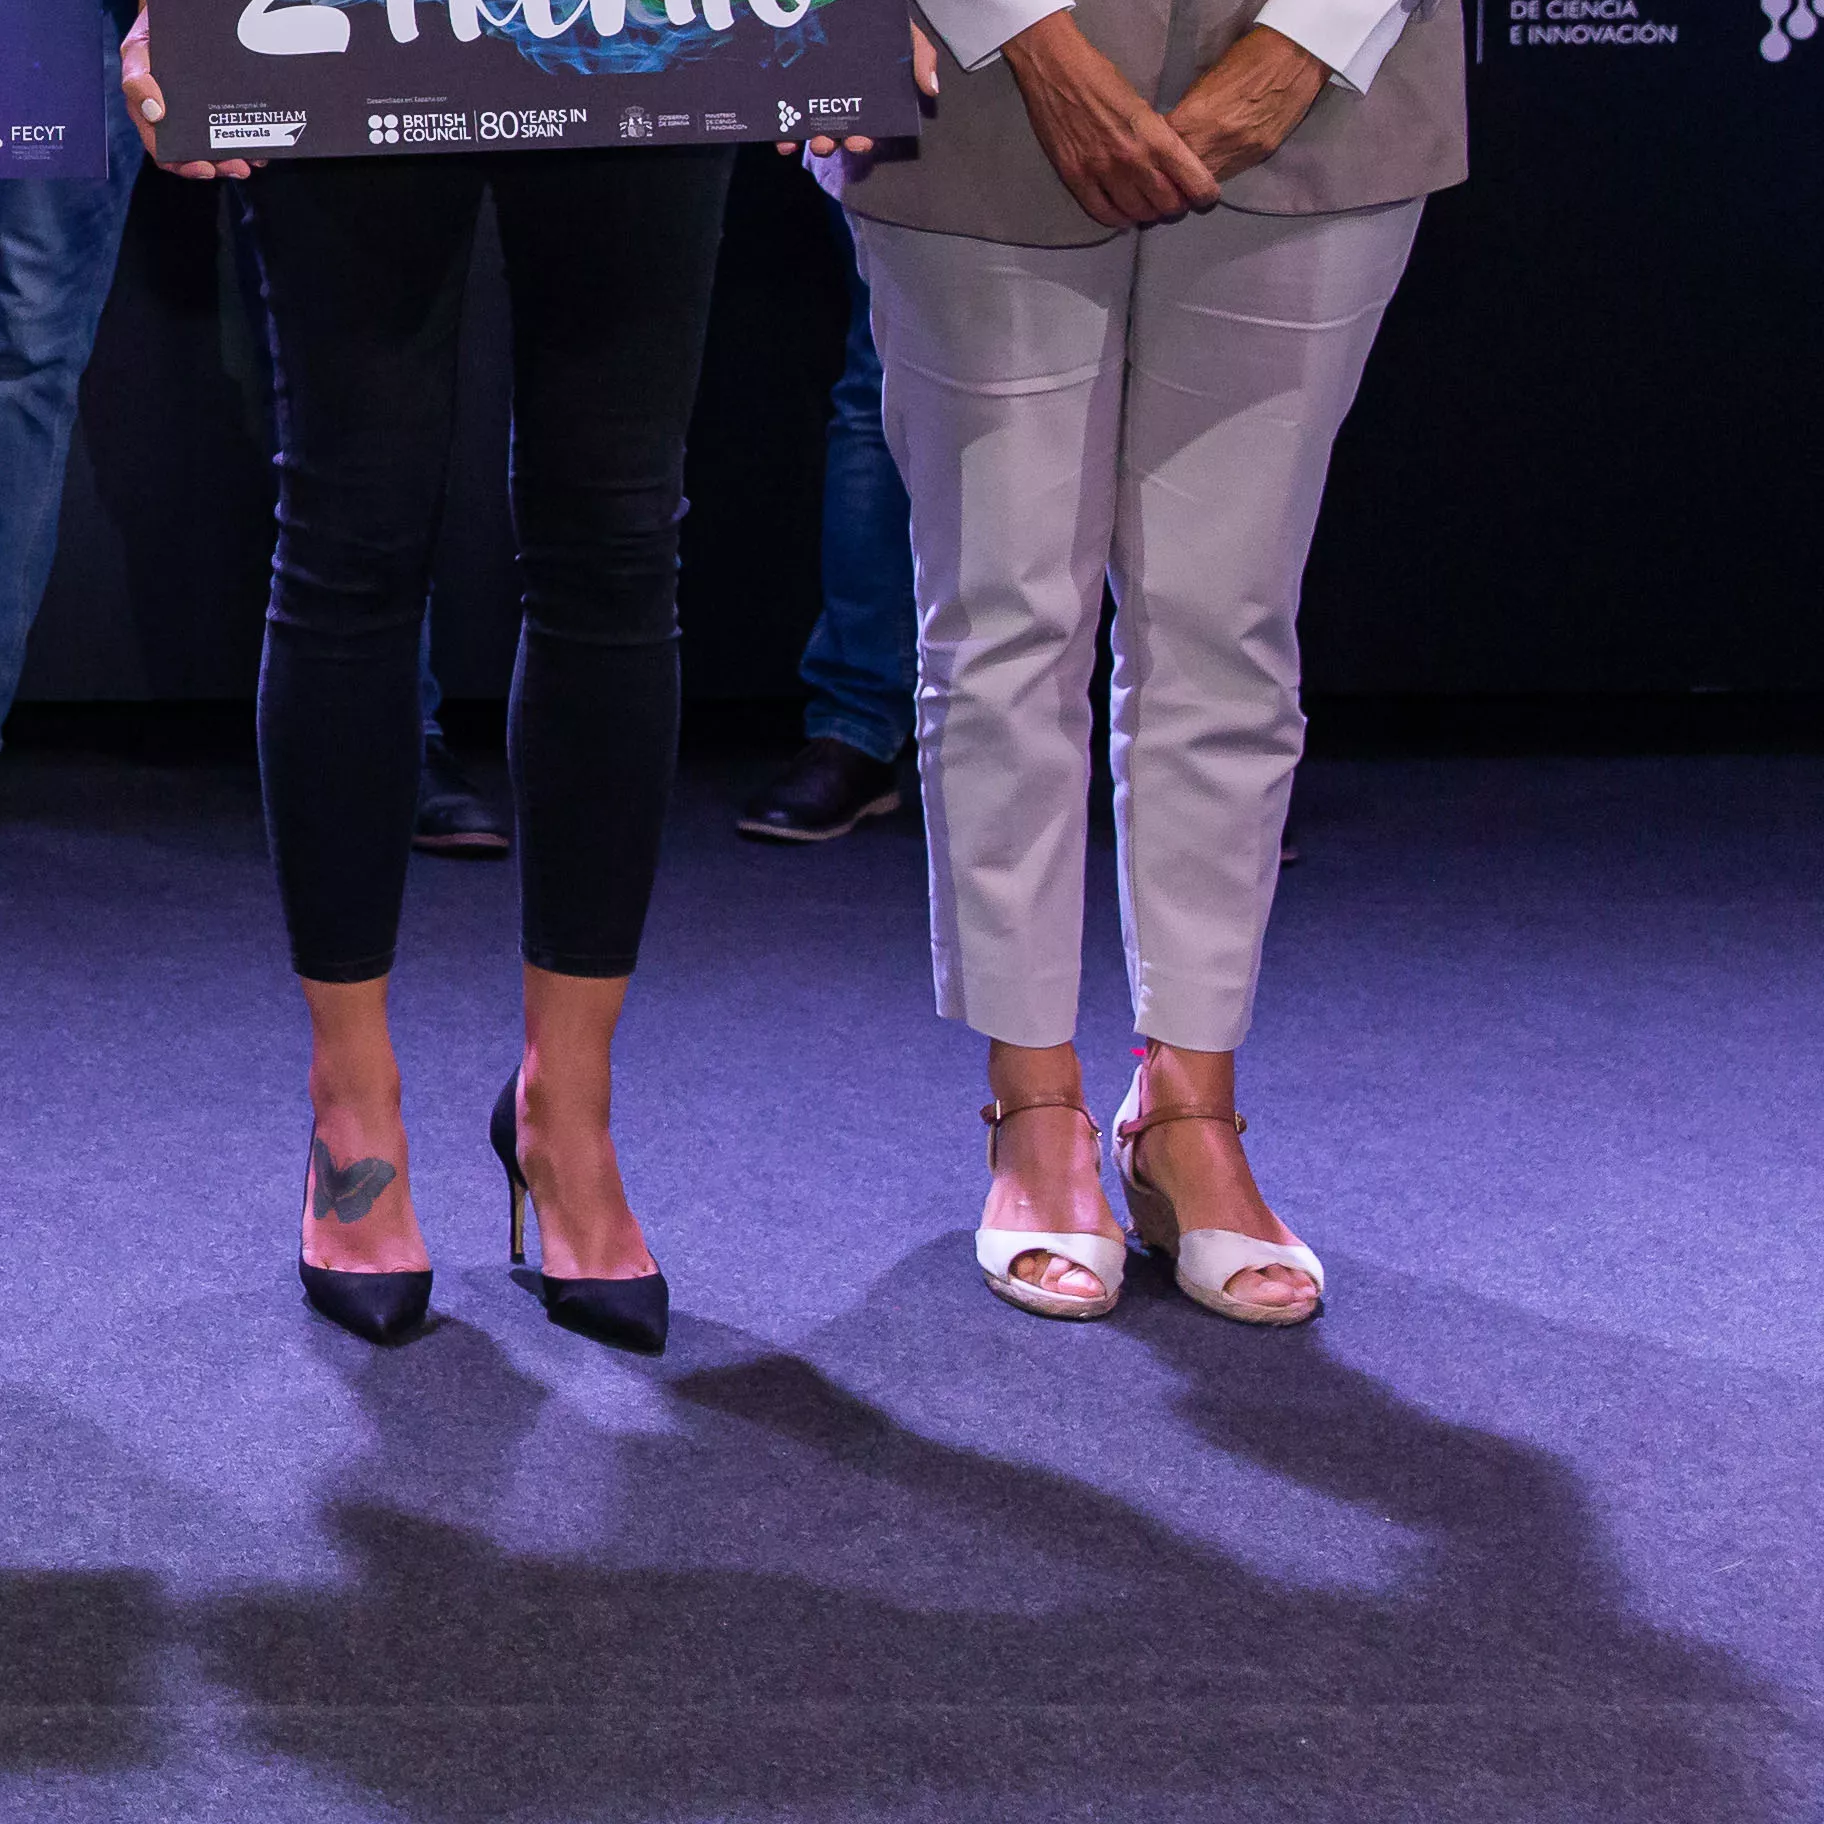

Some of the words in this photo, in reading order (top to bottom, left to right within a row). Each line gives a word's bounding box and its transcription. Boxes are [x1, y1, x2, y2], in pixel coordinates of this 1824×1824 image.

[1510, 0, 1540, 19] DE
[1546, 0, 1639, 19] CIENCIA
[1509, 24, 1522, 45] E
[1528, 20, 1679, 44] INNOVACIÓN
[808, 97, 862, 114] FECYT
[208, 111, 307, 125] CHELTENHAM
[403, 113, 466, 128] BRITISH
[519, 109, 567, 124] YEARS
[570, 108, 587, 122] IN
[11, 125, 65, 141] FECYT
[214, 127, 270, 139] Festivals
[480, 111, 519, 140] 80
[520, 123, 563, 138] SPAIN
[403, 127, 471, 142] COUNCIL
